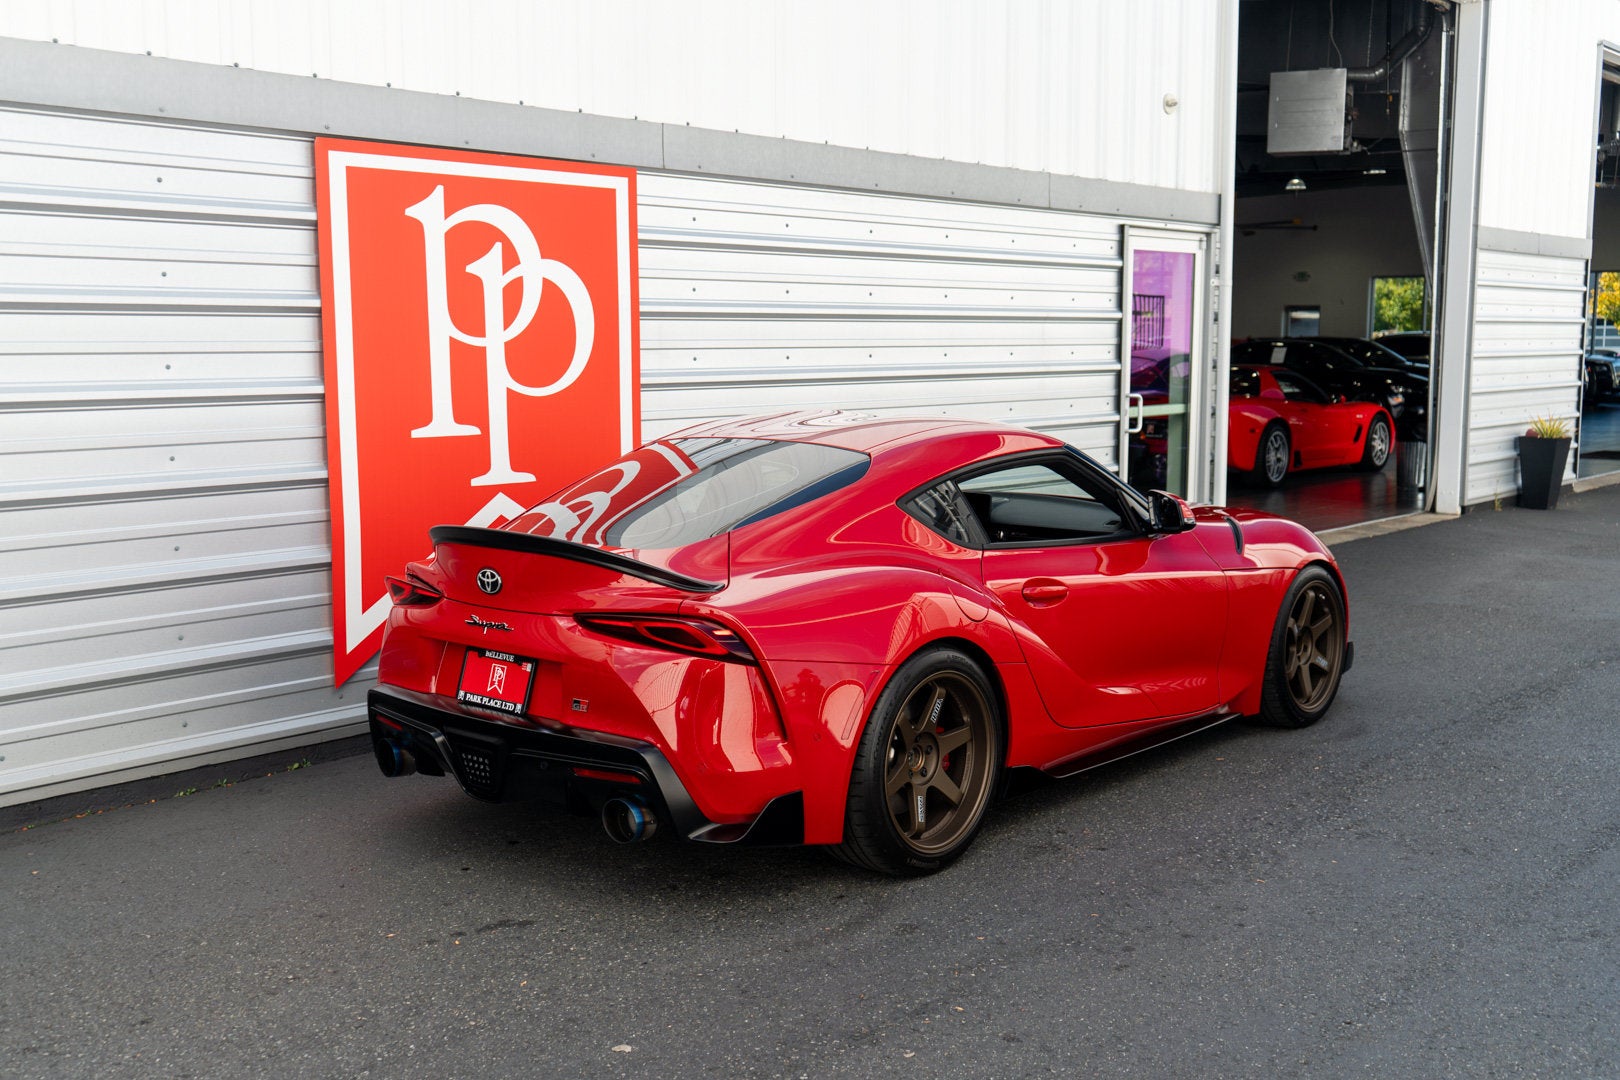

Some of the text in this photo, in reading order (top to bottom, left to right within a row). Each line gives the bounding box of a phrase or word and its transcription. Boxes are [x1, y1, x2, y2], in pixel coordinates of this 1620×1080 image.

[465, 614, 515, 635] Supra
[485, 650, 515, 662] BELLEVUE
[465, 693, 482, 704] PARK
[482, 697, 501, 709] PLACE
[501, 701, 515, 711] LTD
